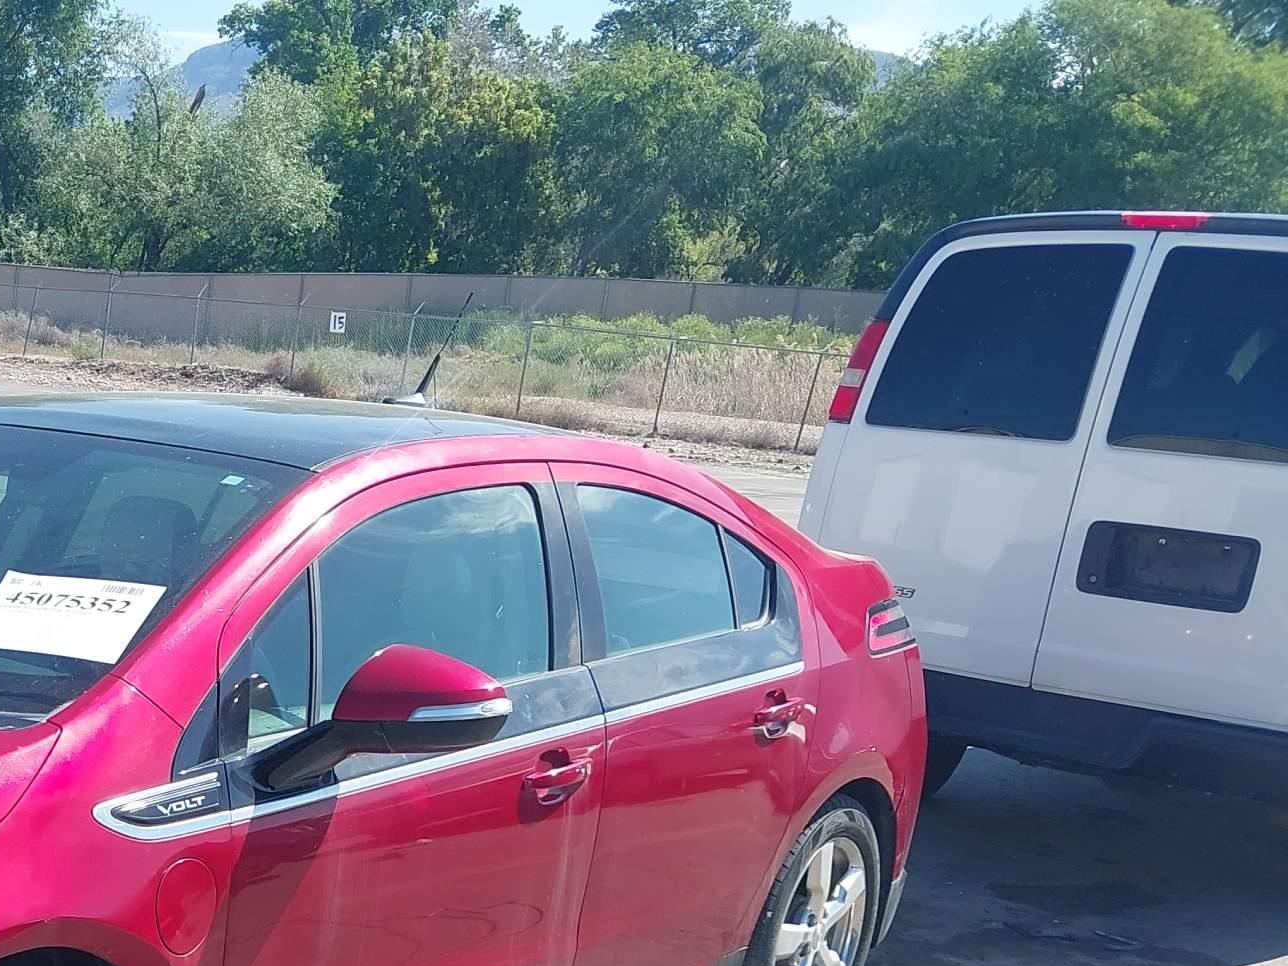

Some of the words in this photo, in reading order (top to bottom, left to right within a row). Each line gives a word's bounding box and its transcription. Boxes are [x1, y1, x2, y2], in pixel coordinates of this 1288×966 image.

[333, 314, 345, 330] 15
[5, 590, 132, 614] 45075352
[156, 795, 206, 816] VOLT
